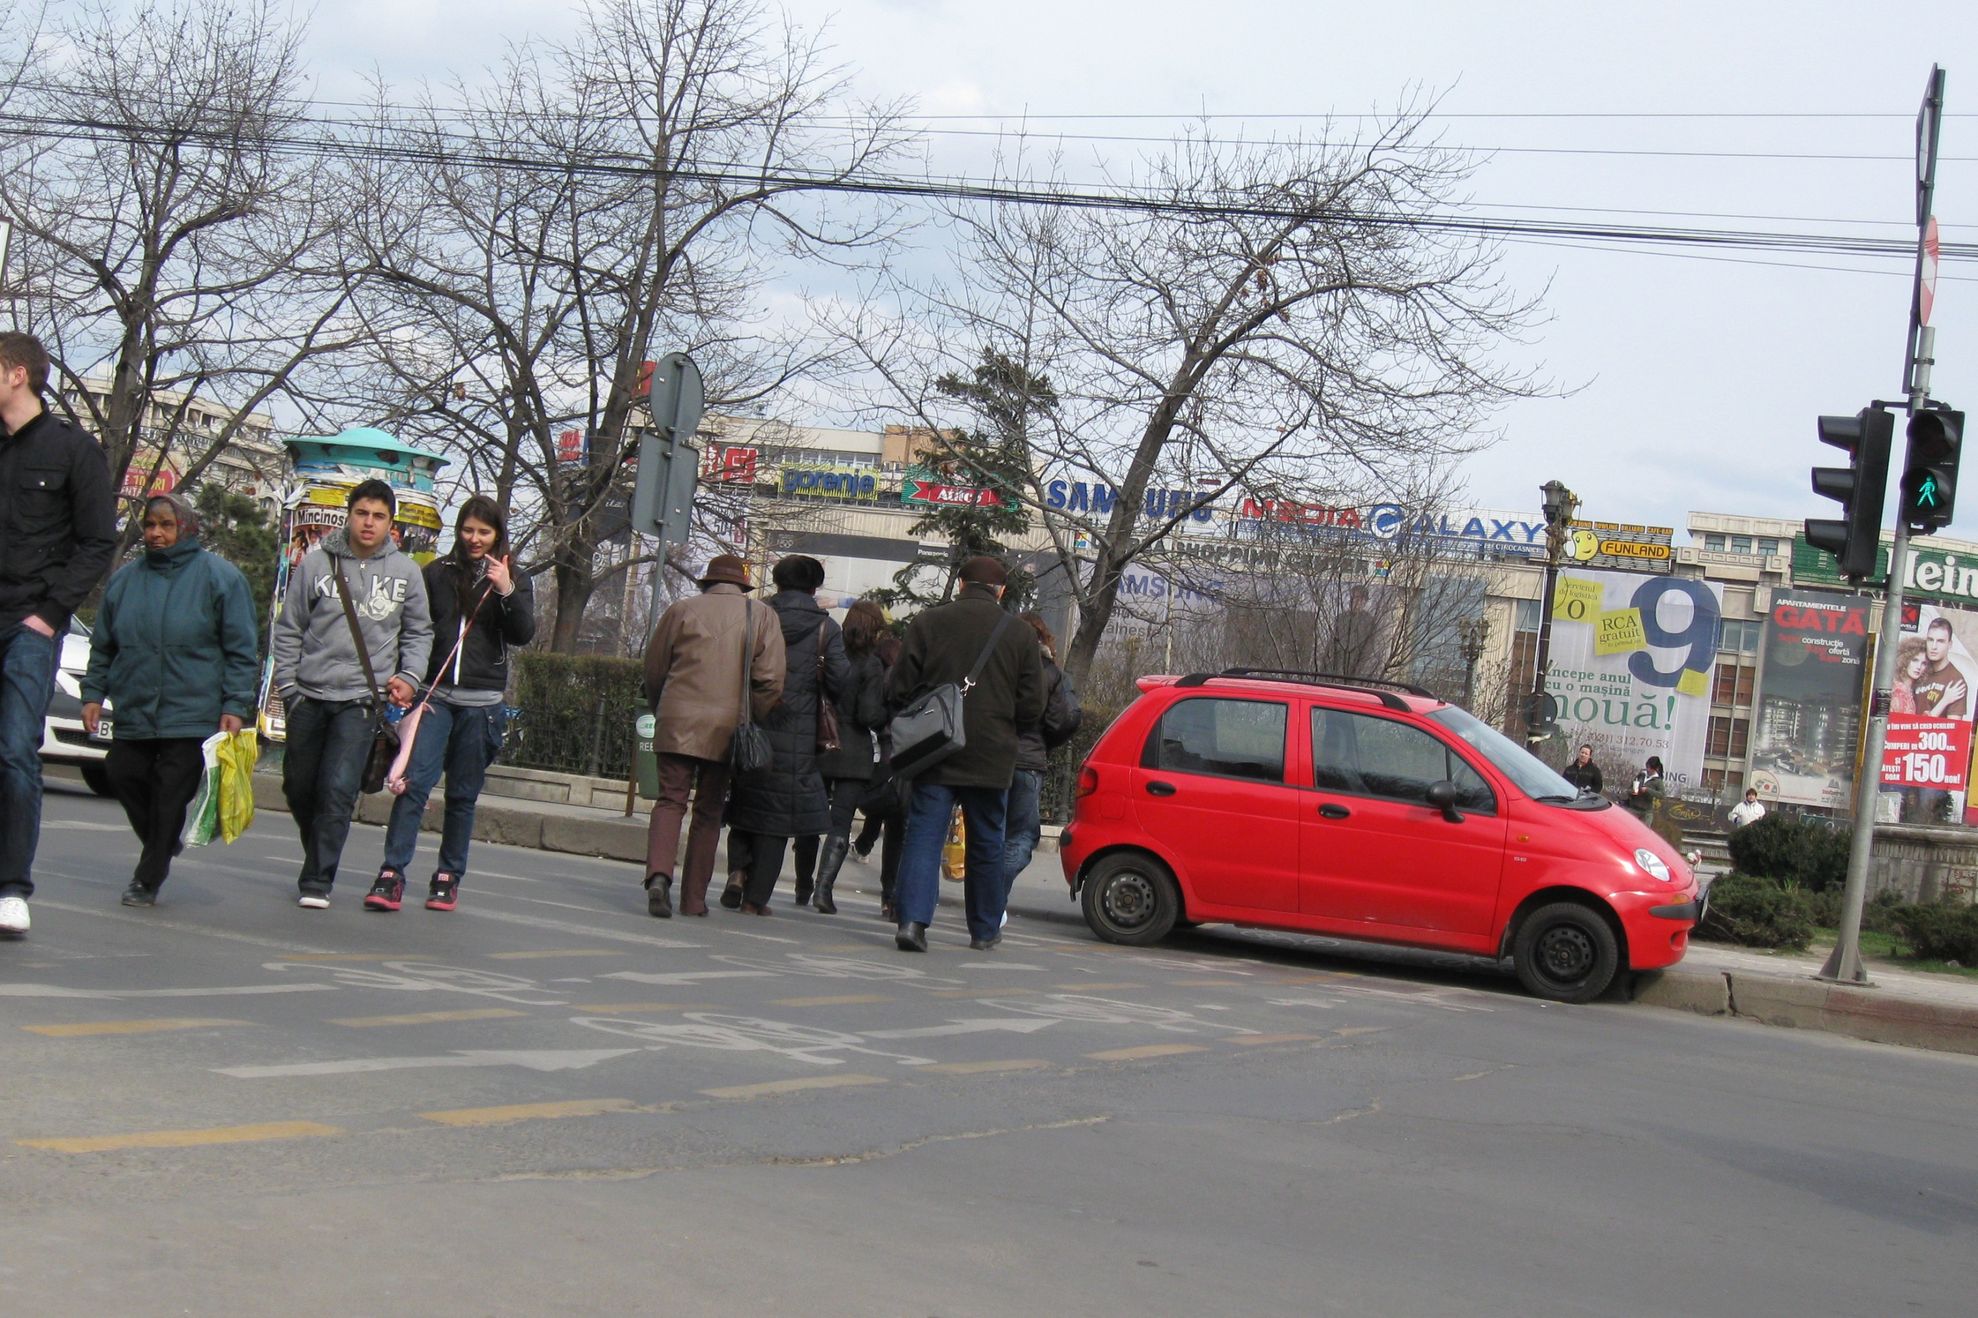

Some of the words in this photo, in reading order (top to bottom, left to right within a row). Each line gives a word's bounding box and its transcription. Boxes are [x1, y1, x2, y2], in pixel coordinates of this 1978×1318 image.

[784, 469, 876, 496] gorenje
[1047, 480, 1214, 523] SAMUNG
[1605, 542, 1665, 557] FUNLAND
[1776, 598, 1847, 612] APARTAMENTELE
[1602, 615, 1637, 632] RCA
[1627, 576, 1721, 687] 9
[1599, 627, 1640, 644] gratuit
[1545, 680, 1561, 689] cu
[1566, 683, 1575, 691] o
[1600, 671, 1632, 685] anul
[1553, 692, 1676, 731] nouă!
[1918, 731, 1948, 751] 300
[1902, 752, 1946, 784] 150
